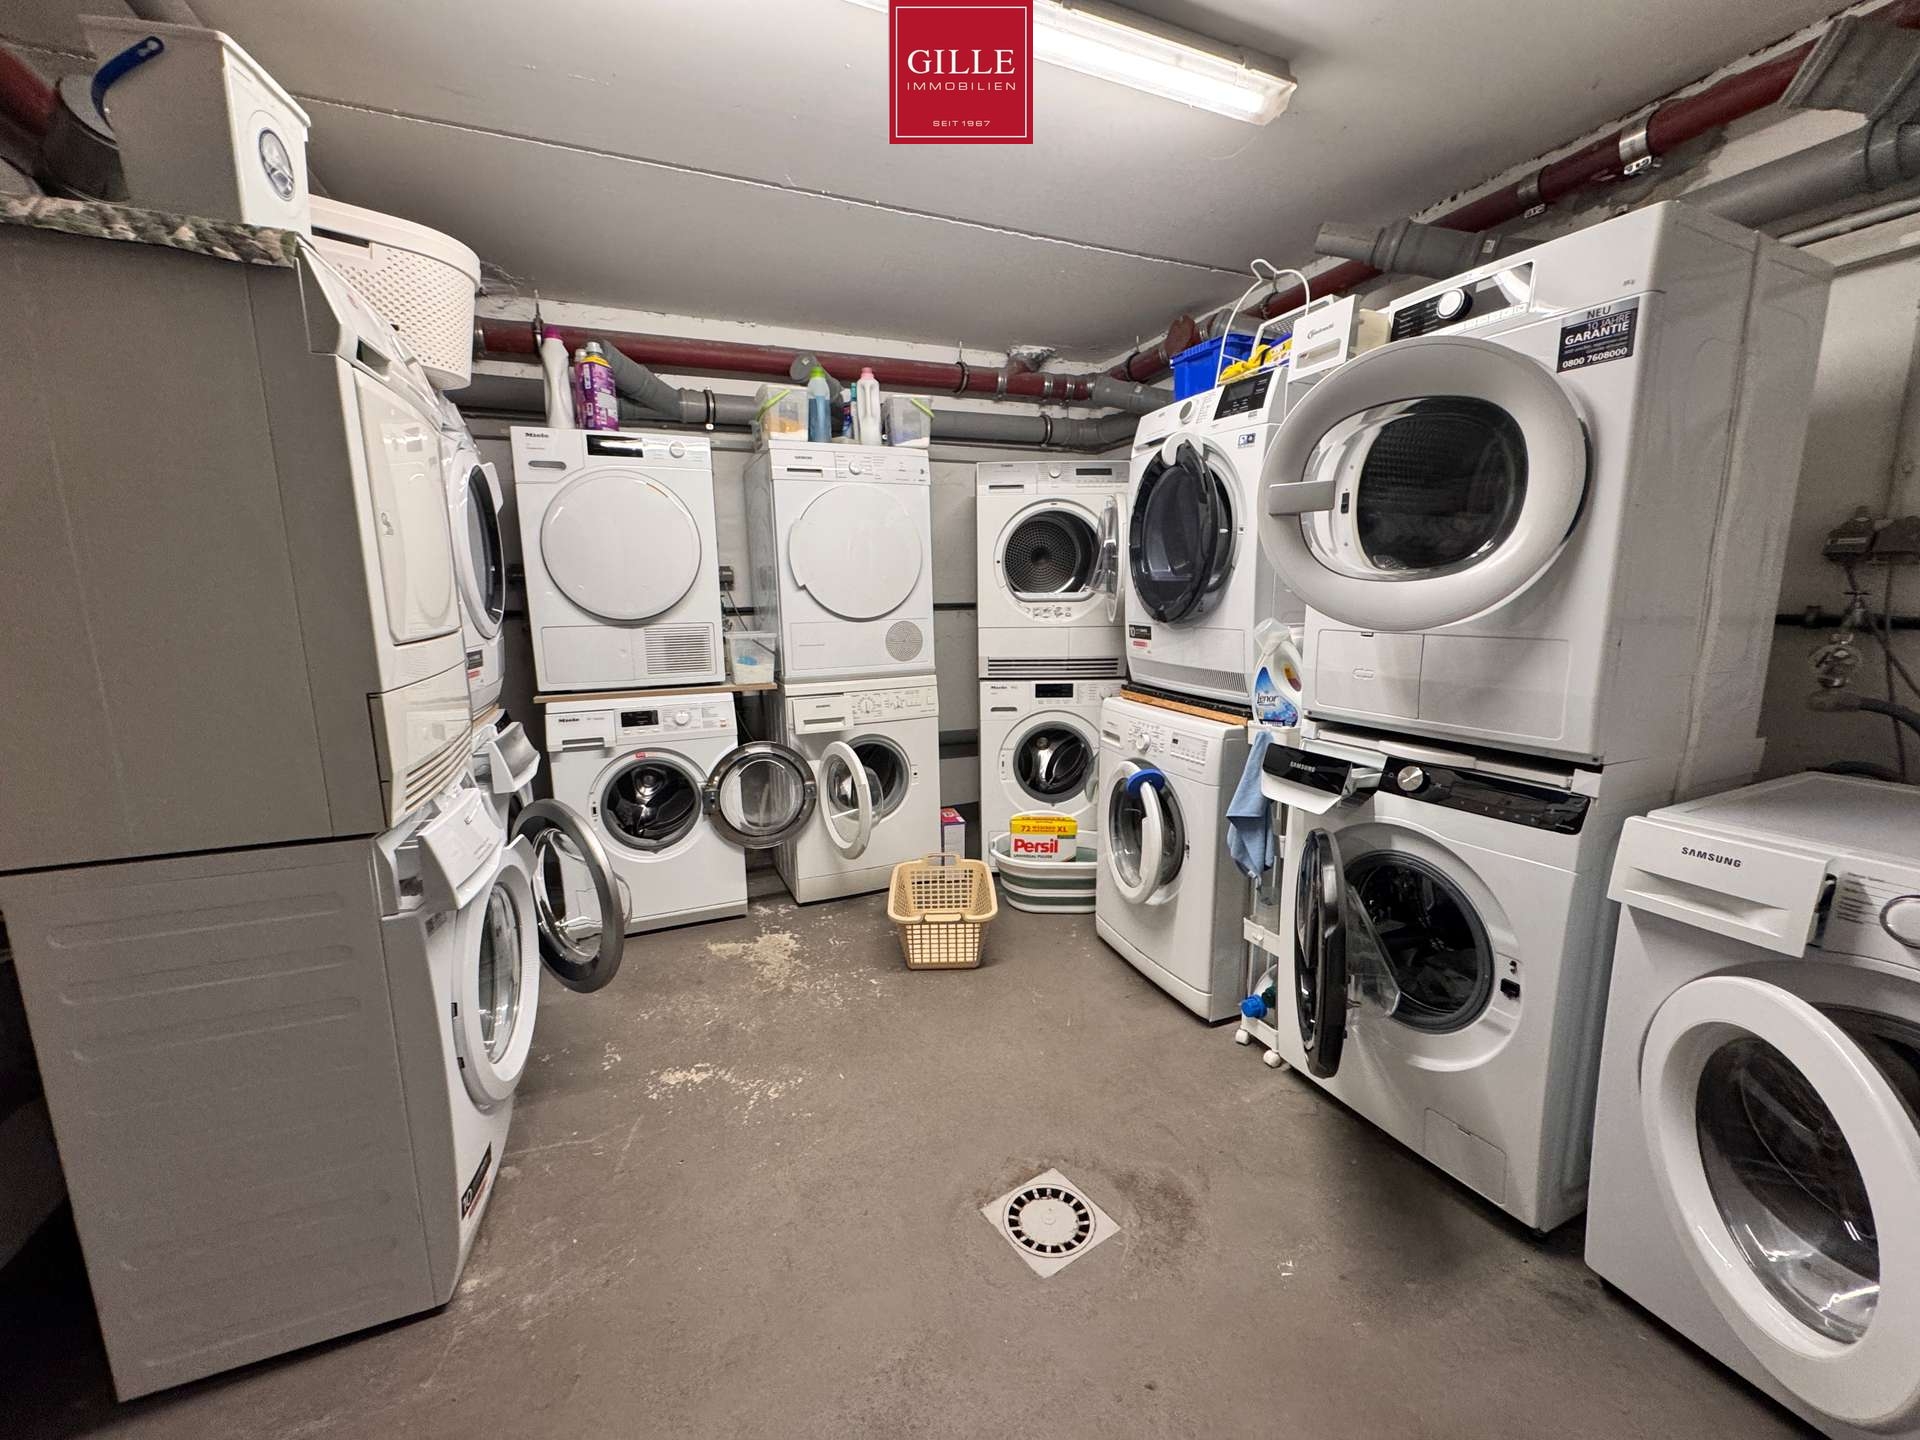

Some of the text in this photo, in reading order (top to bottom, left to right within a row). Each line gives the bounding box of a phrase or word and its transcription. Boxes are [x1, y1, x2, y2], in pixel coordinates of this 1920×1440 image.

[1586, 305, 1612, 320] NEU
[1587, 311, 1632, 331] 10 JAHRE
[1564, 321, 1630, 346] GARANTIE
[1562, 356, 1585, 369] 0800
[1014, 838, 1059, 853] Persil
[1681, 846, 1742, 868] SAMSUNG
